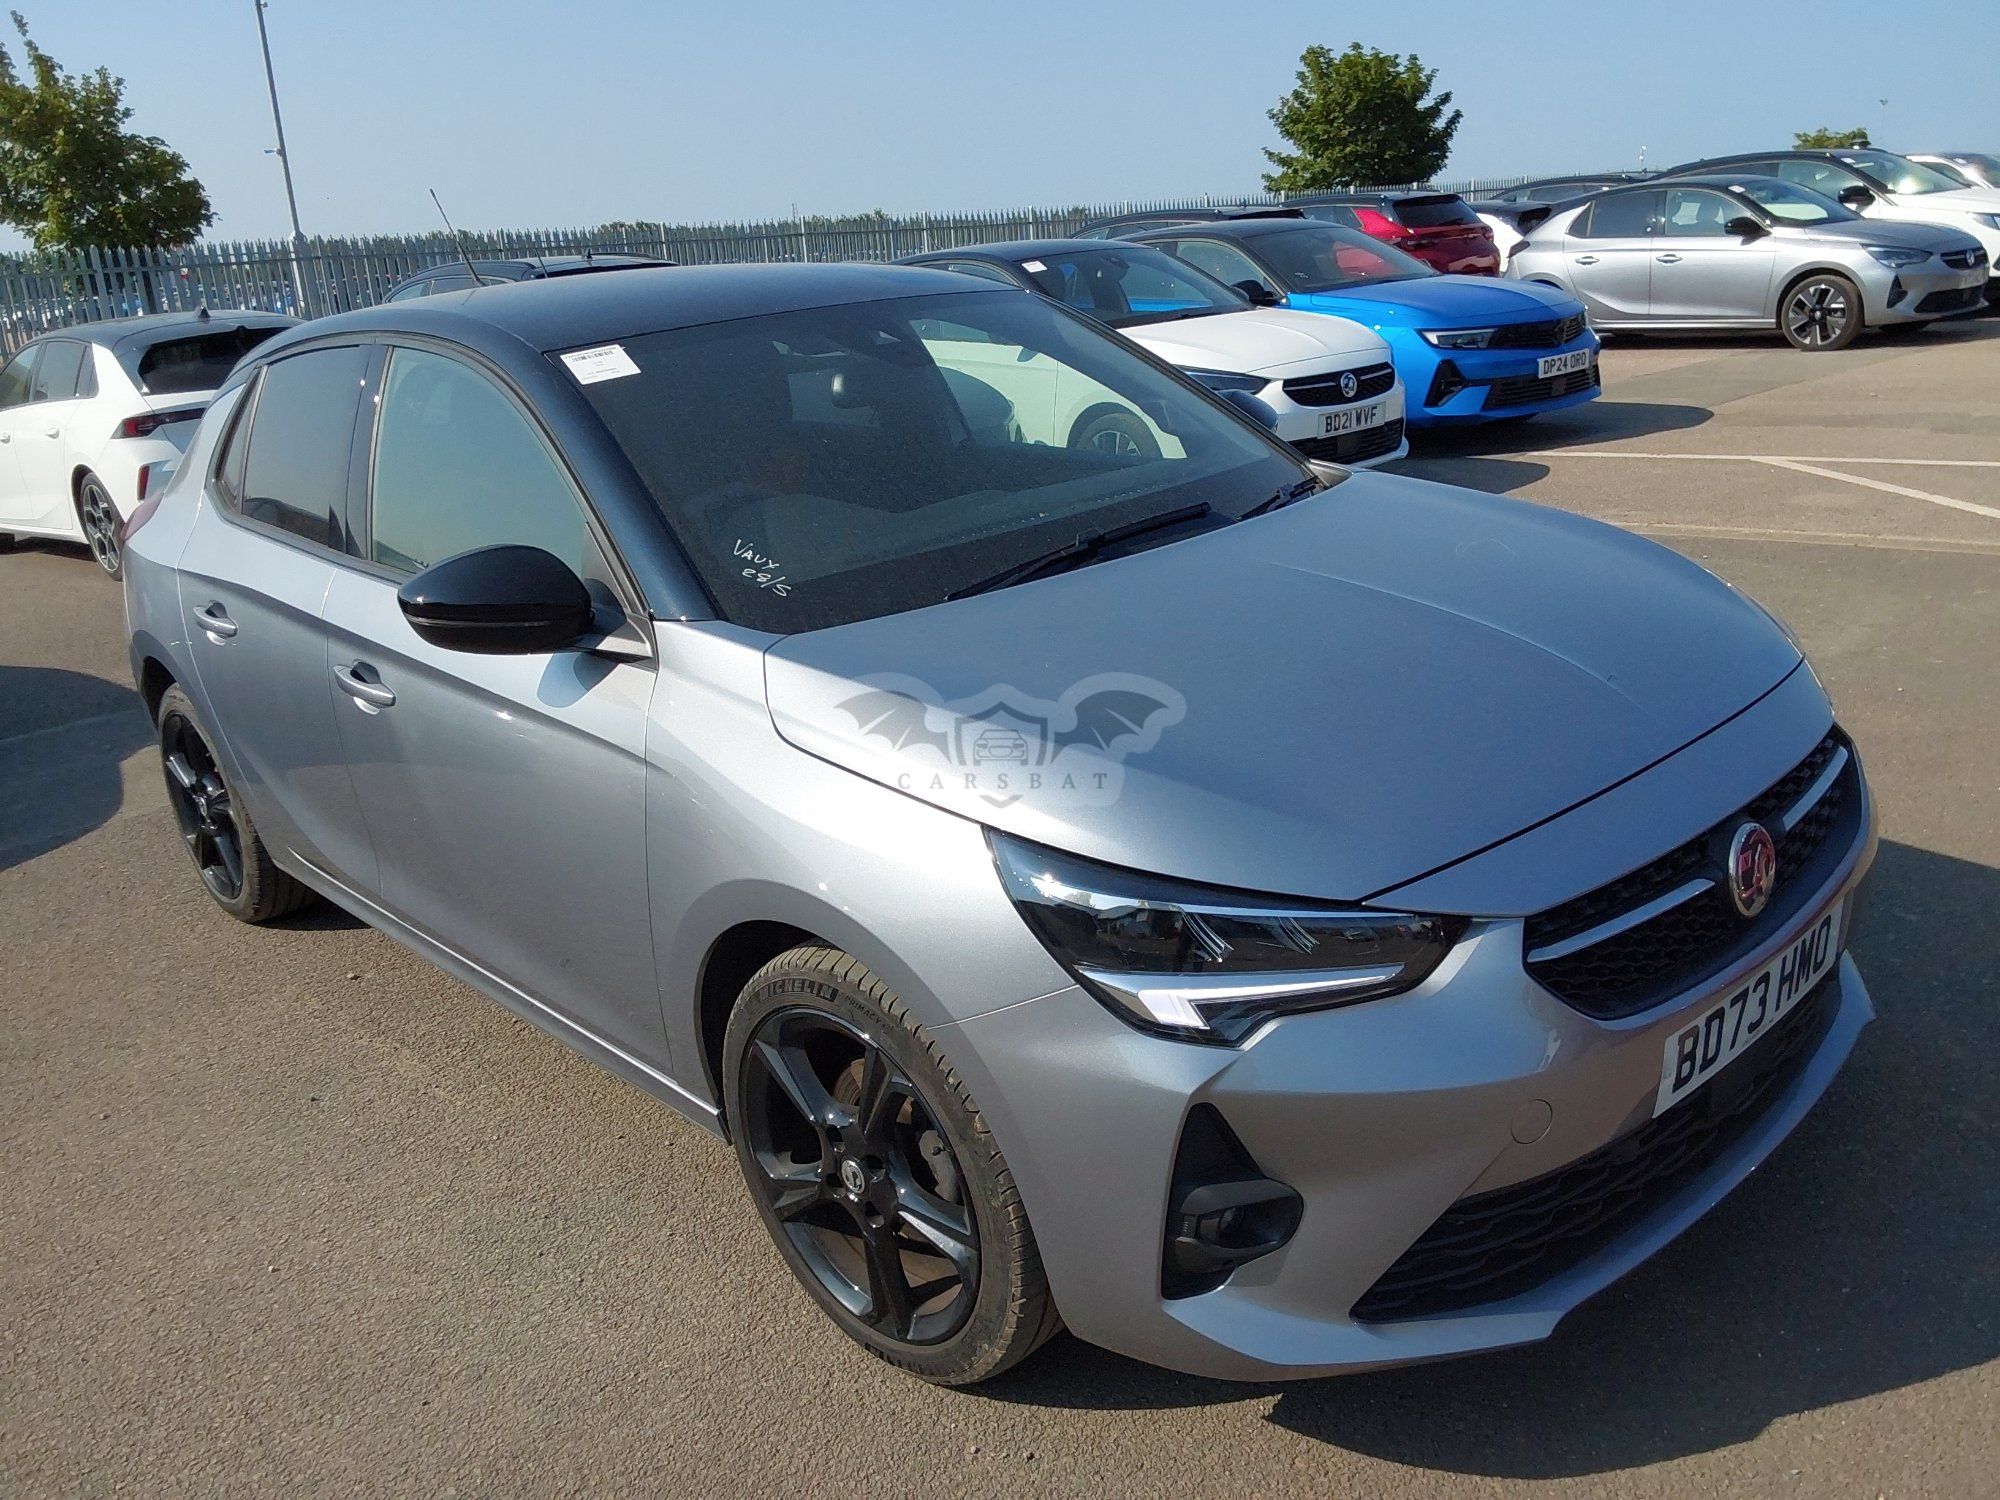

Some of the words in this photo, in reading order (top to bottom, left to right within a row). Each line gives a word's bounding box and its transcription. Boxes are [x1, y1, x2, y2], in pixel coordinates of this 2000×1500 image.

[1543, 356, 1569, 375] DP24
[1325, 411, 1353, 434] BD21
[1355, 405, 1378, 427] WVF
[758, 979, 834, 1000] MICHELIN
[1672, 970, 1771, 1094] BD73
[1774, 913, 1832, 1013] HMO
